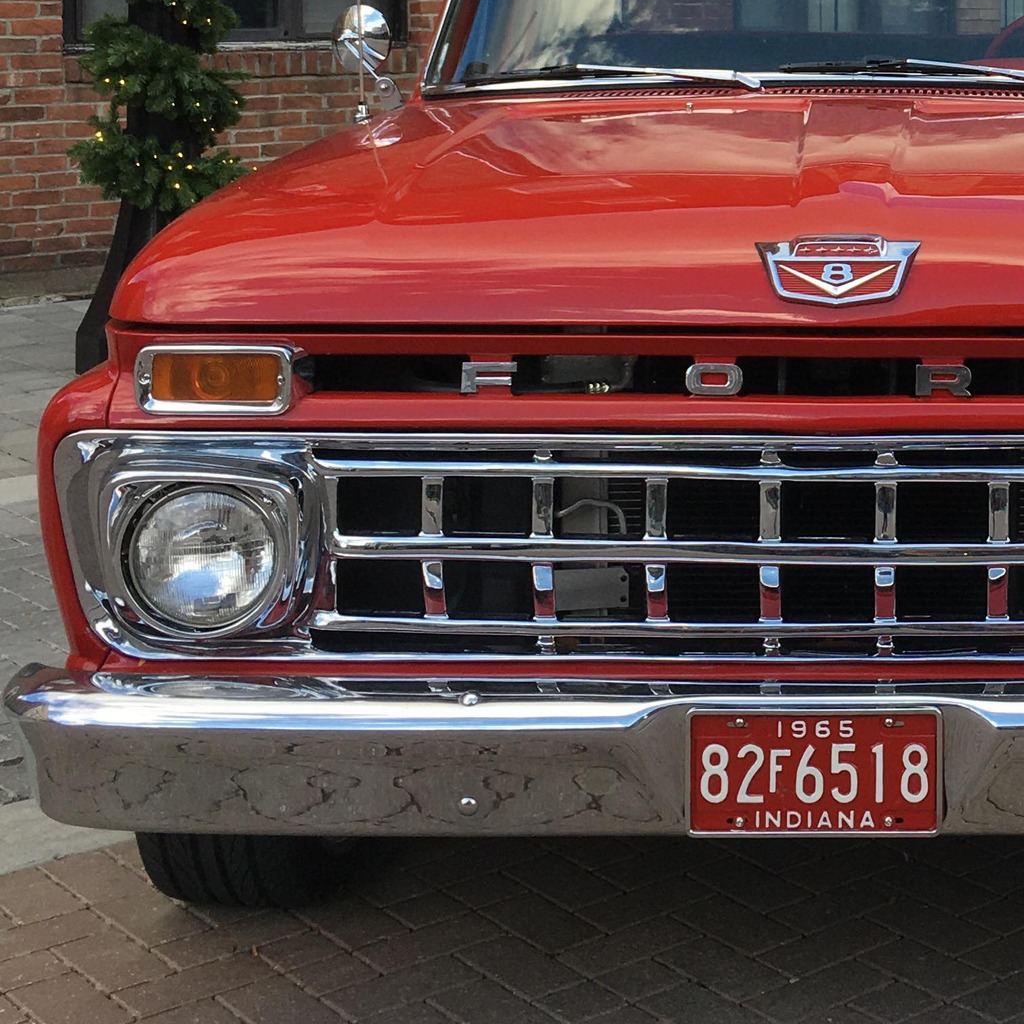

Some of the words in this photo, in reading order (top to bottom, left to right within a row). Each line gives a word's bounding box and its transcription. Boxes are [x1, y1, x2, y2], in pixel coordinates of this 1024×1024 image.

[821, 263, 854, 284] 8
[777, 720, 854, 738] 1965
[700, 743, 929, 804] 82F6518
[755, 810, 875, 828] INDIANA
